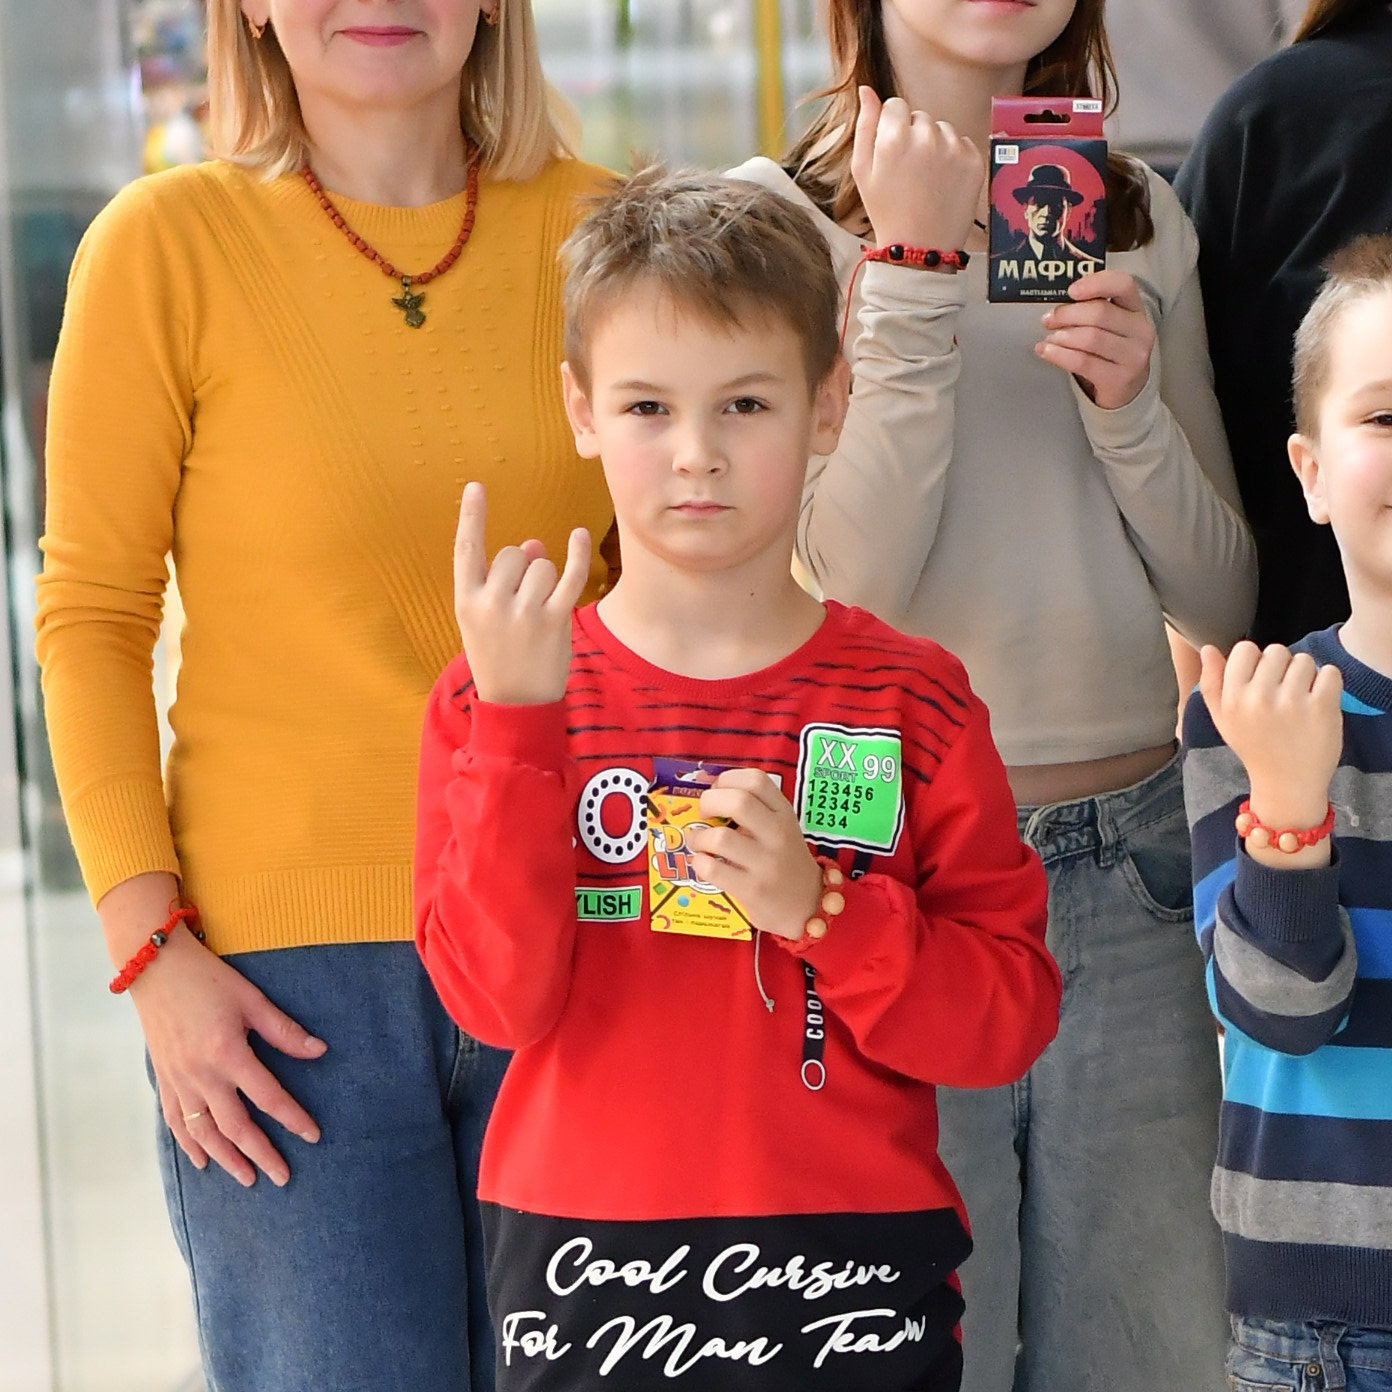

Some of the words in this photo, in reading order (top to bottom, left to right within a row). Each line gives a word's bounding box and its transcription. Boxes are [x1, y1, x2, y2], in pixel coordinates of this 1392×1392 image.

[998, 260, 1095, 281] МАФІЯ
[1057, 289, 1068, 297] ГР
[814, 767, 858, 783] SPORT
[818, 738, 858, 771] XX
[863, 754, 896, 783] 99
[546, 1237, 691, 1297] Cool
[703, 1243, 900, 1301] Cursive
[502, 1310, 572, 1366] For
[586, 1314, 783, 1378] Man
